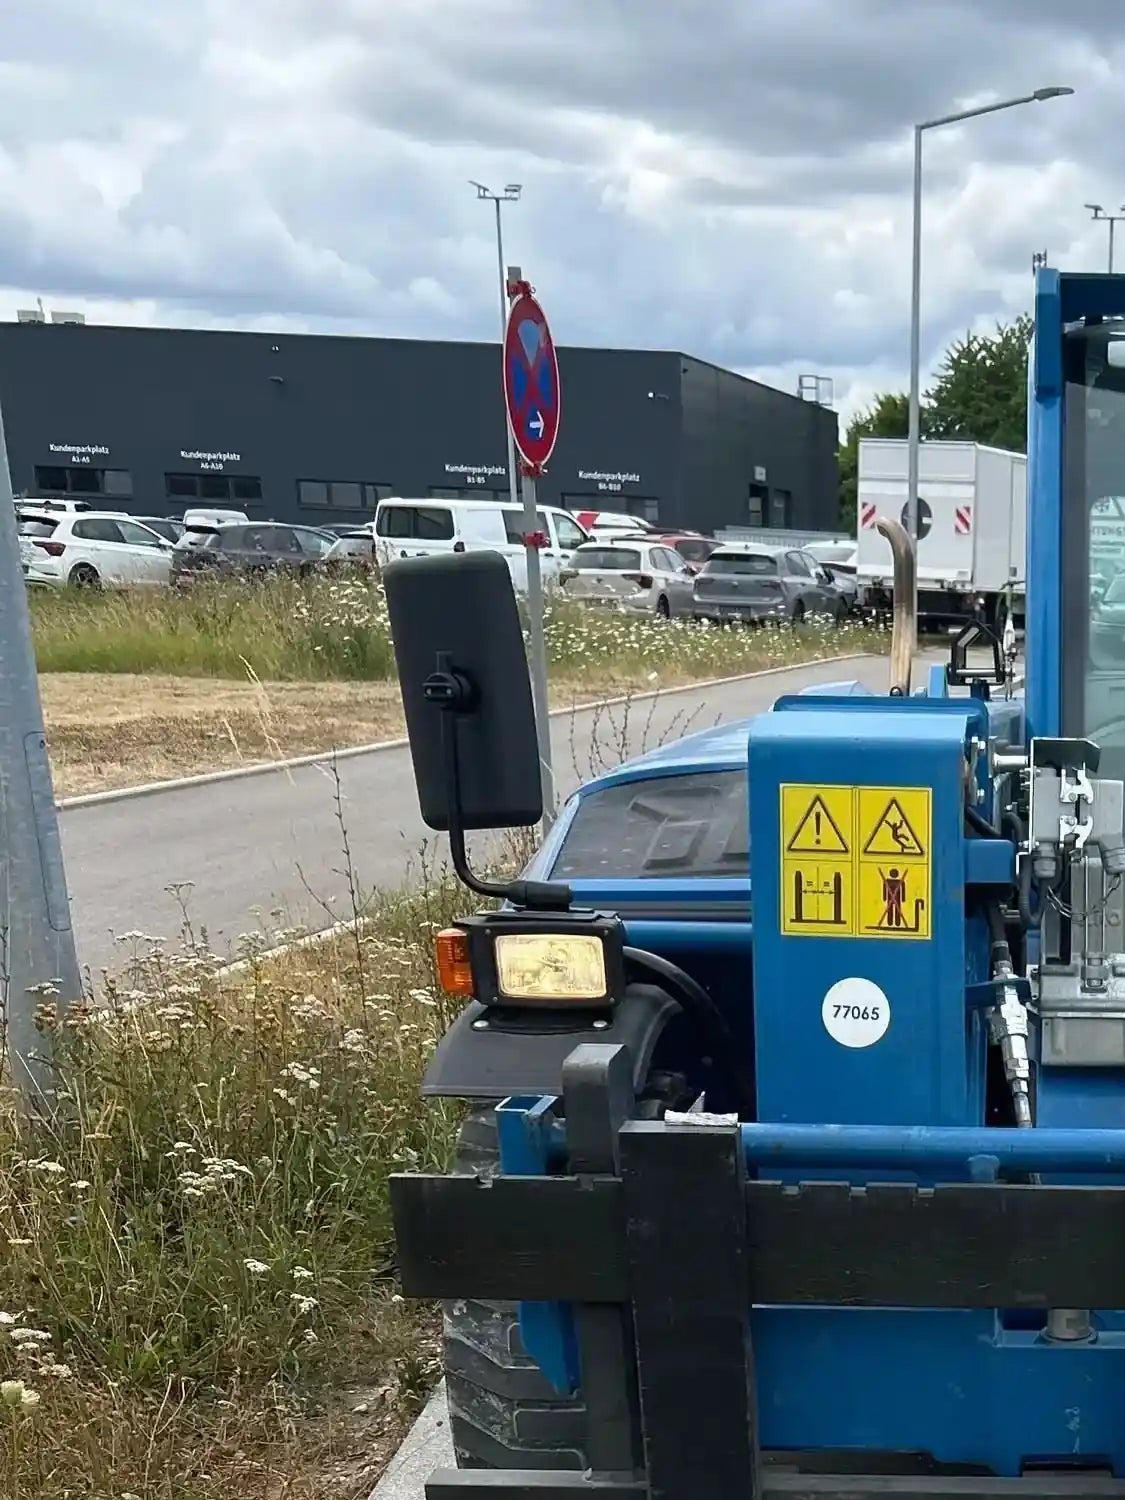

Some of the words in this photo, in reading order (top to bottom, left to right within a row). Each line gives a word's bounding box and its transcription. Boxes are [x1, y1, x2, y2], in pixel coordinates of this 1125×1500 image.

[49, 443, 109, 455] Kundenparkplatz
[180, 450, 241, 462] Kundenparkplatz
[444, 464, 506, 476] Kundenparkplatz
[578, 470, 640, 482] Kundenparkplatz
[832, 1004, 880, 1021] 77065
